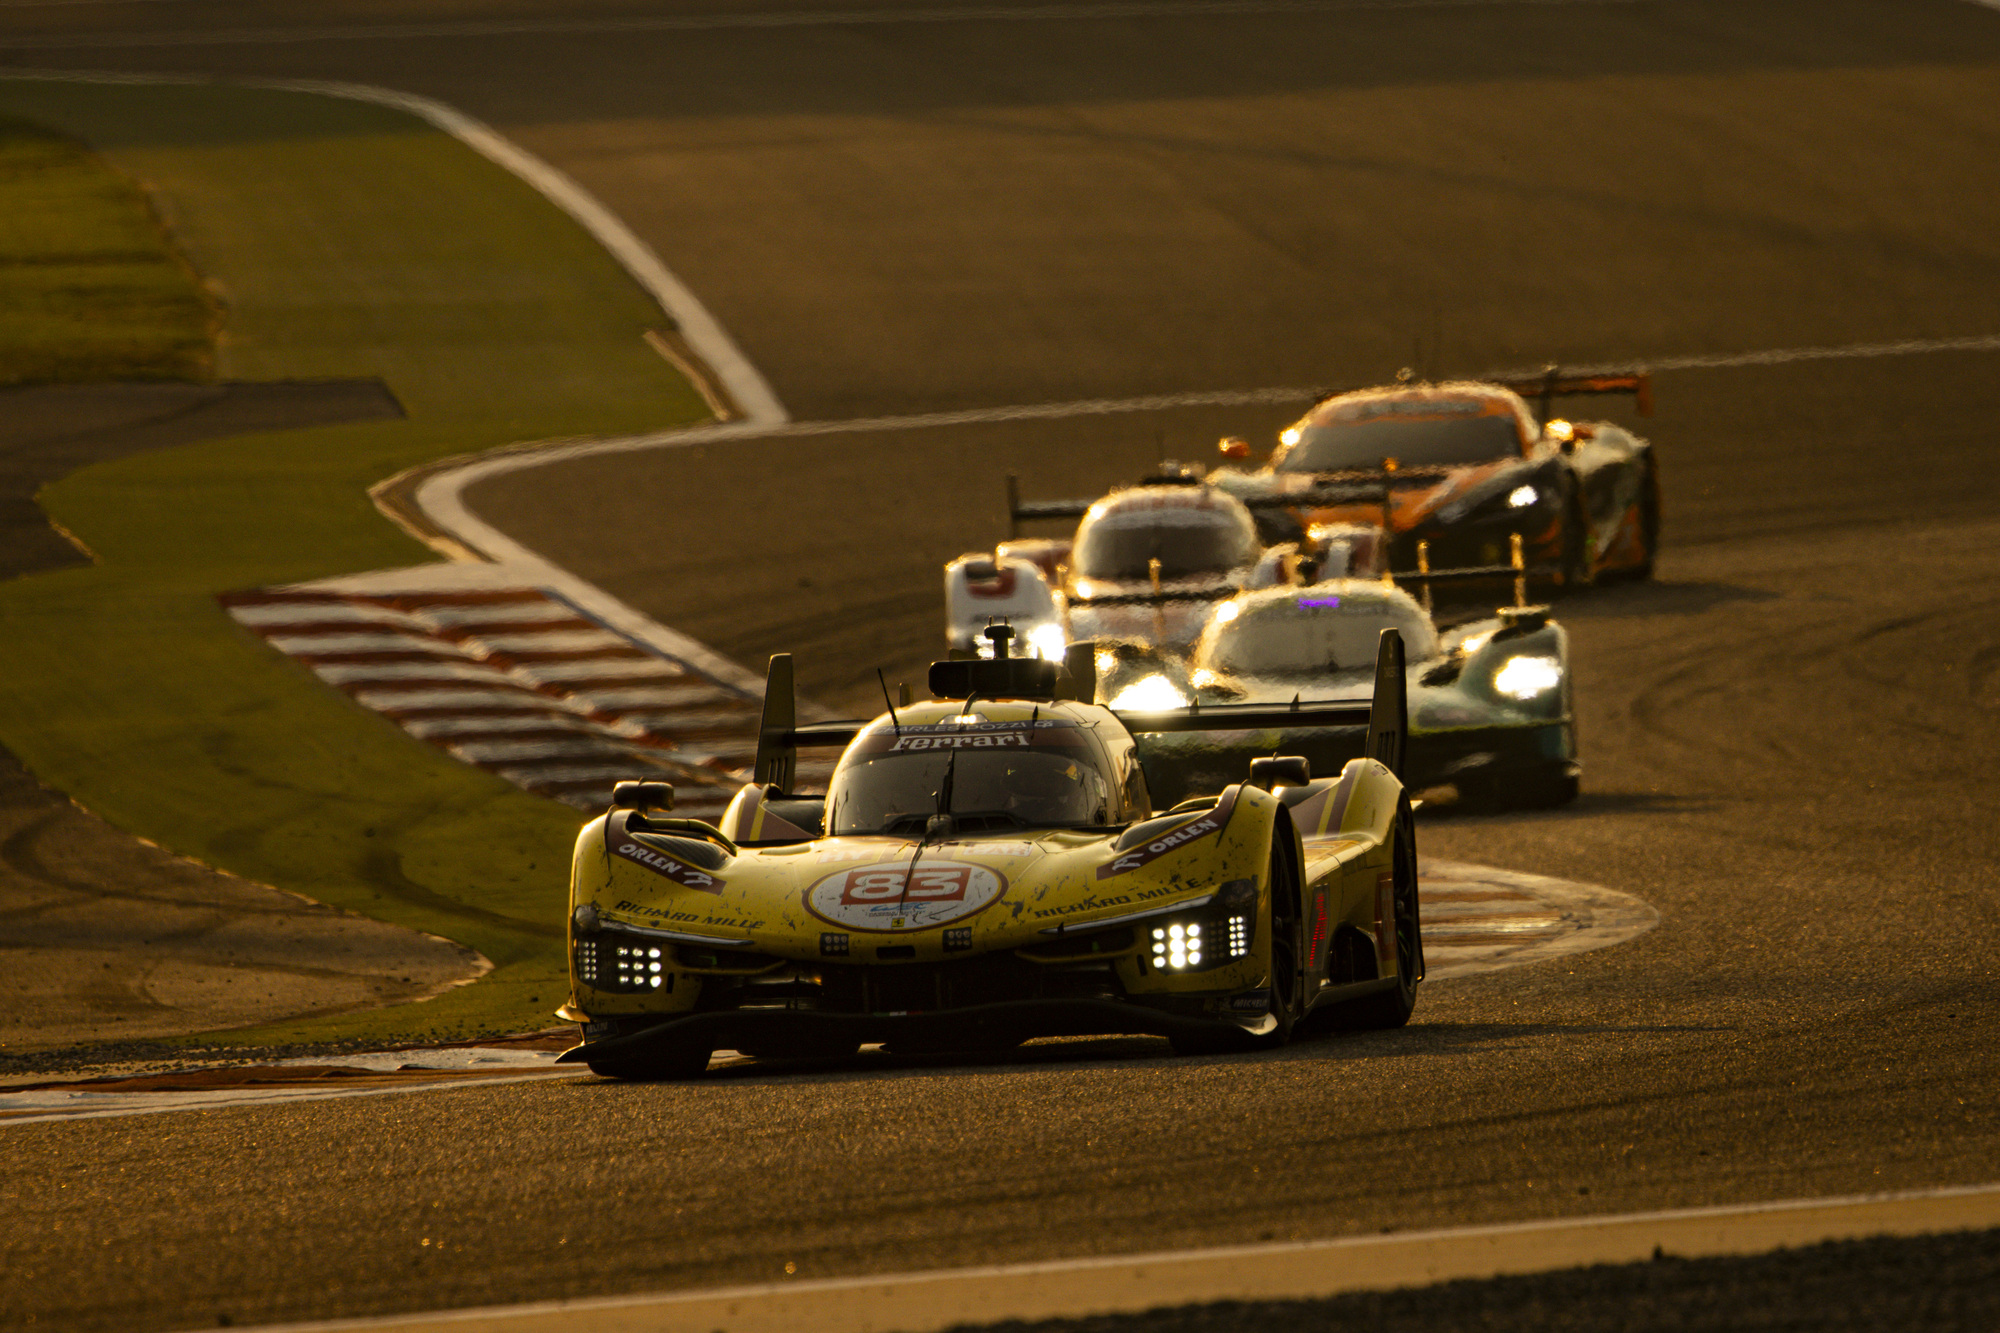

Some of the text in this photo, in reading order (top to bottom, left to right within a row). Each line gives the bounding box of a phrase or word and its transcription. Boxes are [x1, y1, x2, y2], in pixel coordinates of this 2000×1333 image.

[874, 724, 960, 734] CHARLES
[965, 722, 1028, 731] POZZI
[888, 731, 1030, 751] Ferrari
[1148, 819, 1219, 853] ORLEN
[618, 843, 682, 874] ORLEN
[849, 871, 962, 900] 83
[1034, 877, 1202, 919] RICHARD MILLE
[614, 900, 766, 929] RICHARD MILLE
